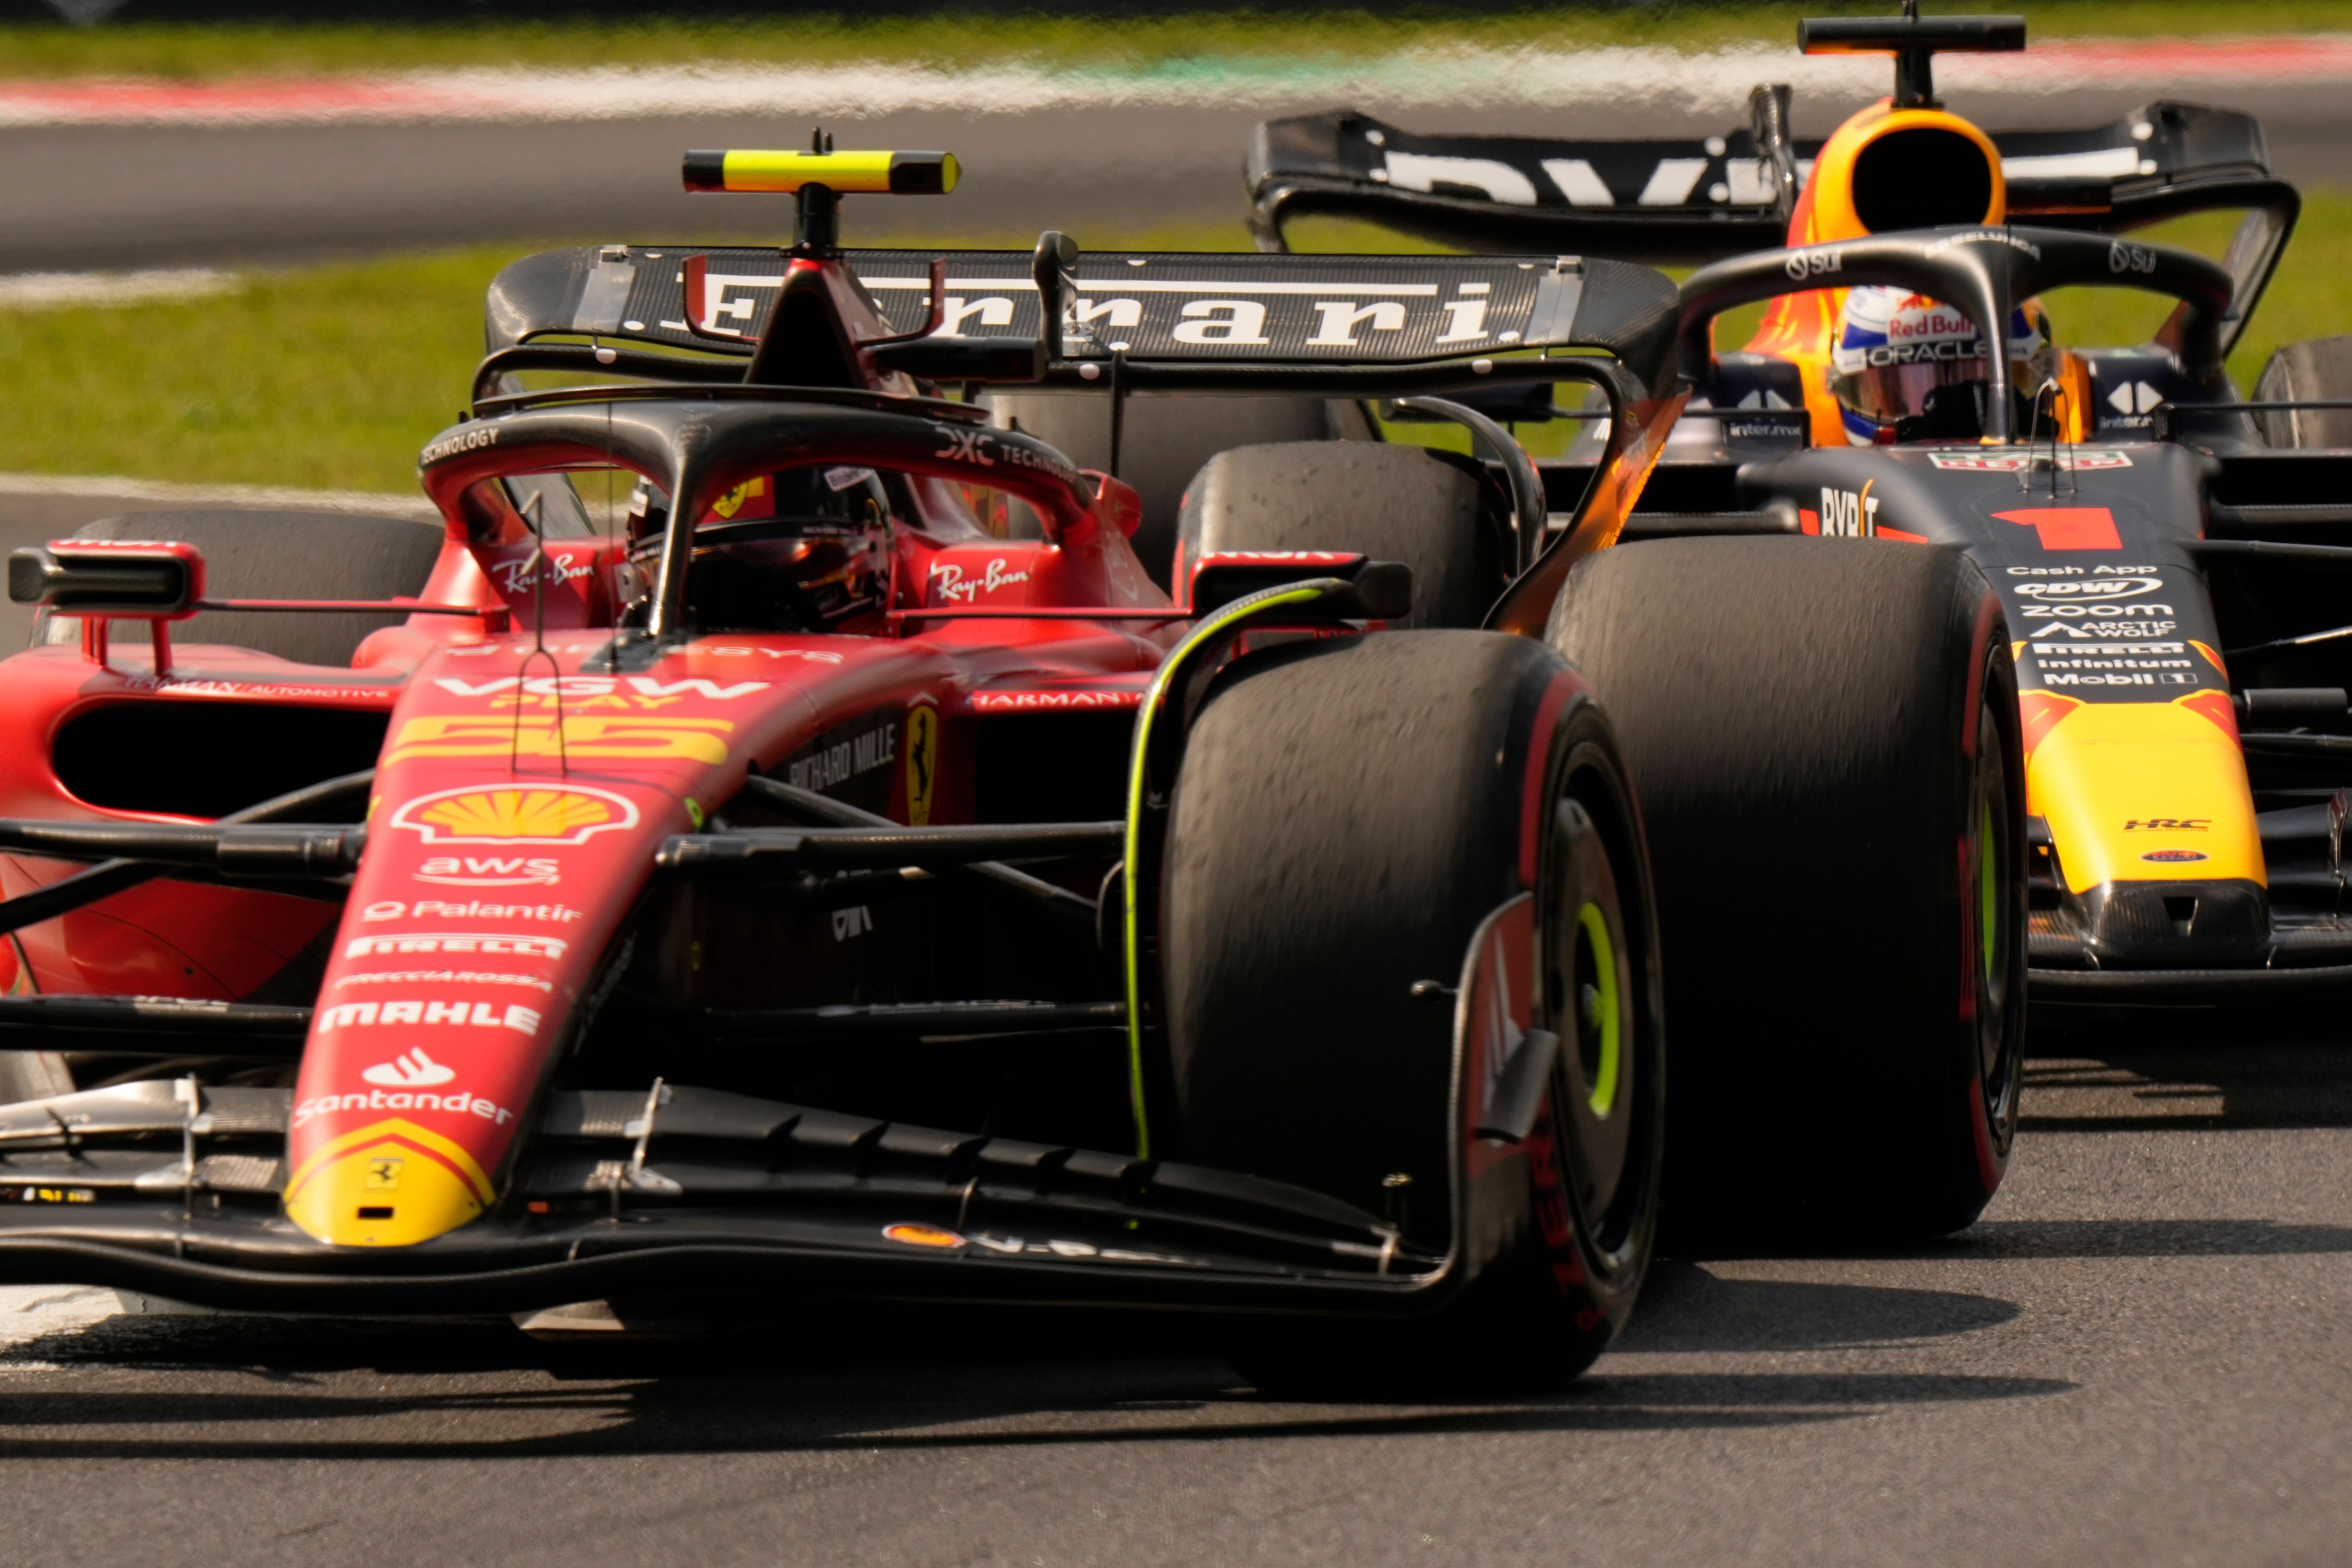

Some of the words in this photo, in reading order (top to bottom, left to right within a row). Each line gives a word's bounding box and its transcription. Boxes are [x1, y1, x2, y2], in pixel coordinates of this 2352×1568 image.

[660, 272, 1490, 345] Frrari
[1889, 314, 1928, 338] Red
[1932, 314, 1972, 333] Bull
[1869, 340, 1988, 368] ORACLE
[1730, 421, 1802, 437] inter.mx
[935, 426, 995, 466] DXC
[1990, 507, 2122, 550] 1
[930, 558, 1029, 602] Ray-Ban
[2006, 565, 2084, 575] Cash
[2092, 565, 2158, 574] App
[2020, 604, 2174, 617] zoom
[2081, 621, 2177, 629] ARCTIC
[2095, 629, 2171, 637] WOLF
[2032, 642, 2185, 654] PIRELLI
[2038, 659, 2192, 668] infinitum
[434, 675, 771, 699] VGW
[2043, 674, 2154, 685] Mobil
[251, 686, 389, 698] AUTOMOTIVE
[488, 694, 683, 709] PLAY
[965, 692, 1121, 706] HARMAN
[382, 714, 735, 769] 55
[854, 723, 895, 775] MILLE
[2123, 818, 2212, 830] HRC
[419, 857, 561, 877] aws
[412, 900, 582, 924] Palantir
[344, 932, 568, 960] PIRELLI
[318, 1001, 542, 1036] MAHLE
[293, 1090, 514, 1127] Santander
